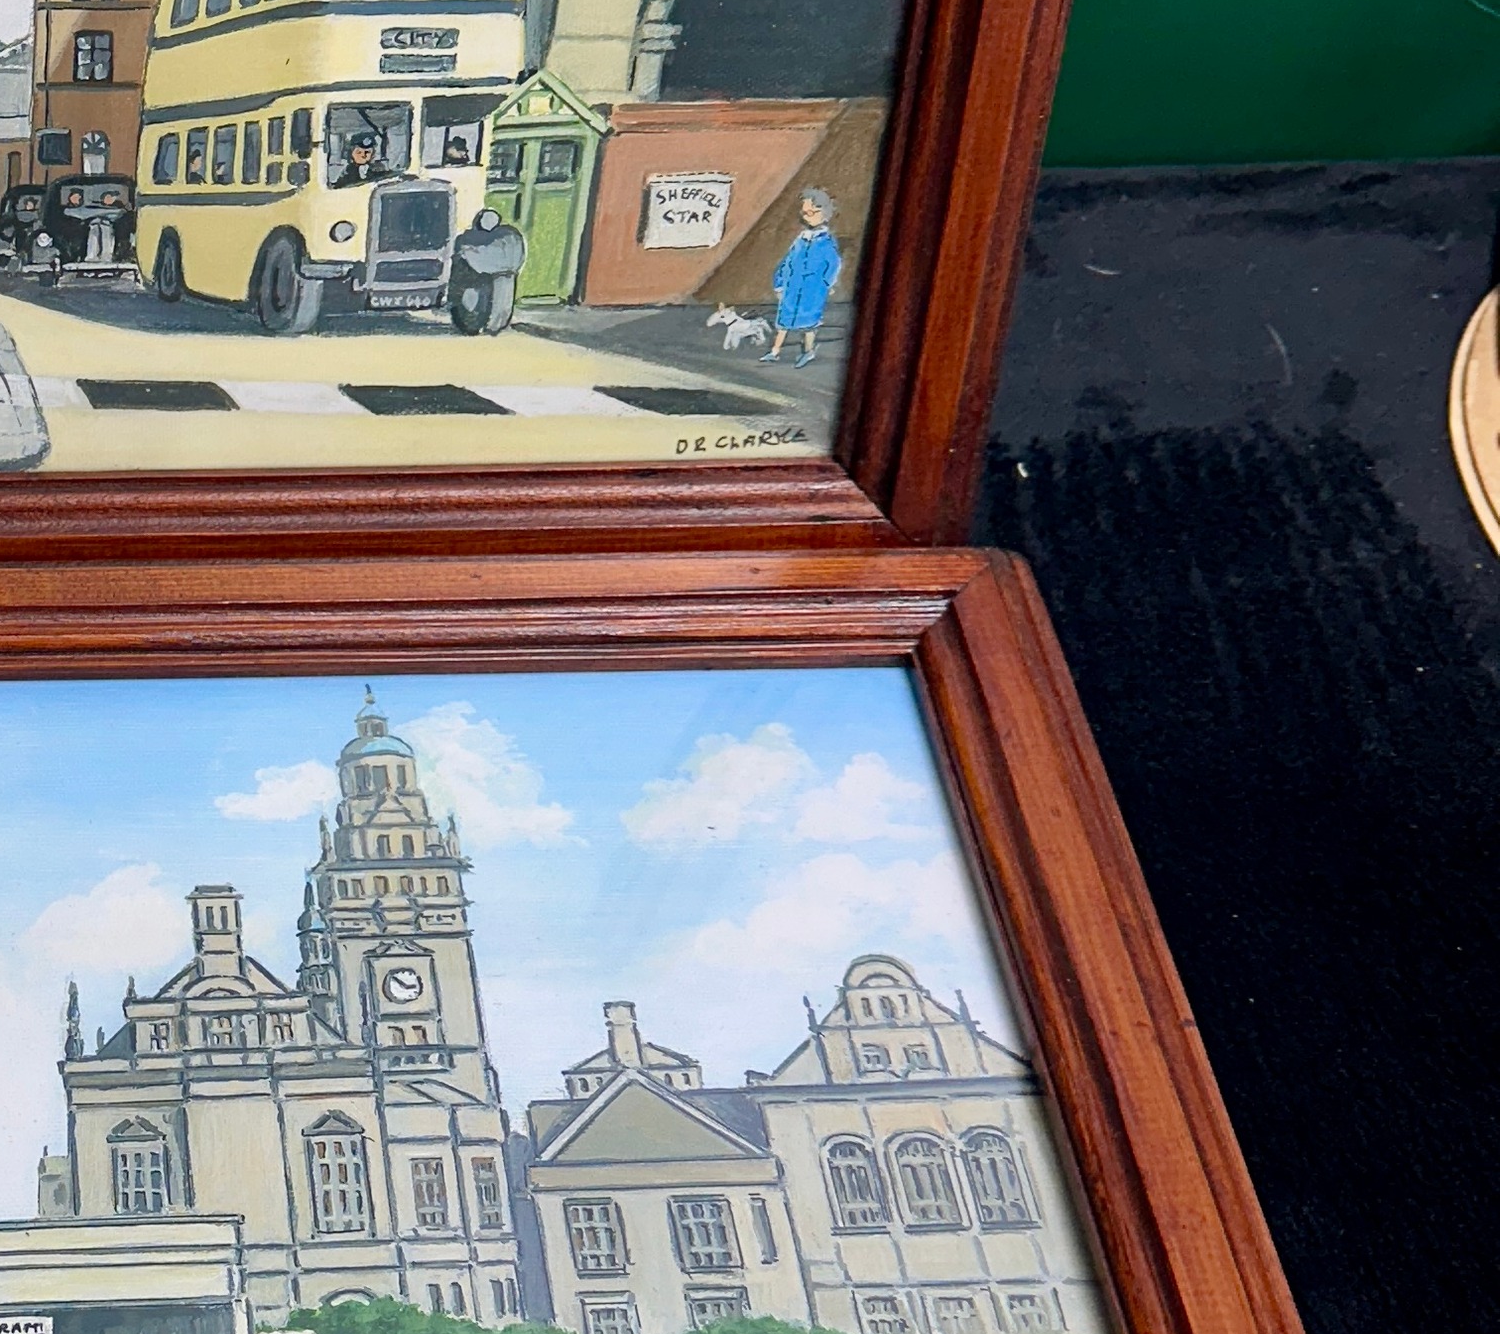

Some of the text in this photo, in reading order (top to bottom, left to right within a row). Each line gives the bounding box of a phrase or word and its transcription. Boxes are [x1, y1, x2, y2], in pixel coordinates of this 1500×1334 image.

[394, 29, 448, 48] CITY
[662, 209, 712, 224] STAR
[715, 427, 809, 450] CLARKE
